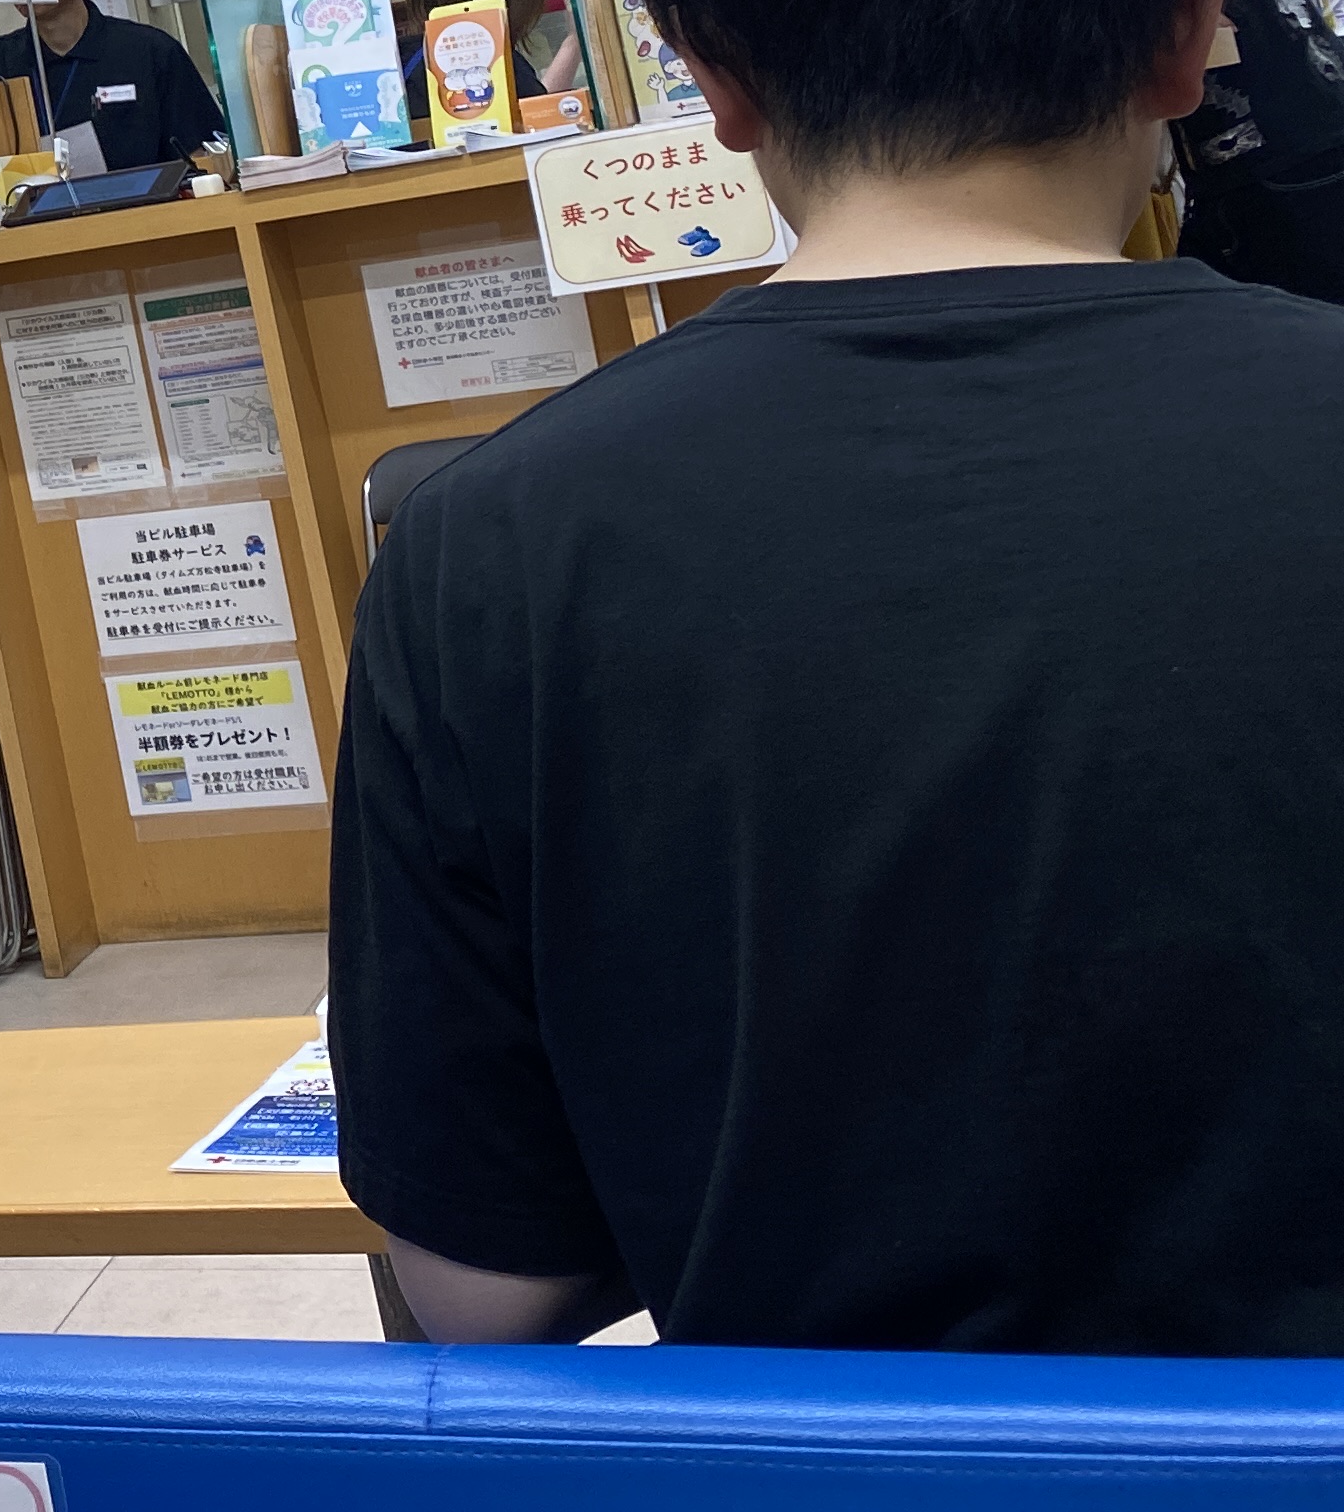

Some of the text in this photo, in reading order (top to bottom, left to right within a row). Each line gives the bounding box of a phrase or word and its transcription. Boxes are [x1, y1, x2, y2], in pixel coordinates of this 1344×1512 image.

[582, 142, 708, 181] くつのまま
[561, 179, 746, 229] 乗ってください
[415, 255, 515, 279] 献血者の皆さまへ
[136, 523, 215, 544] 当ビル駐車場
[131, 544, 227, 564] 駐車券サービス
[138, 727, 291, 753] 半額券をプレゼント！
